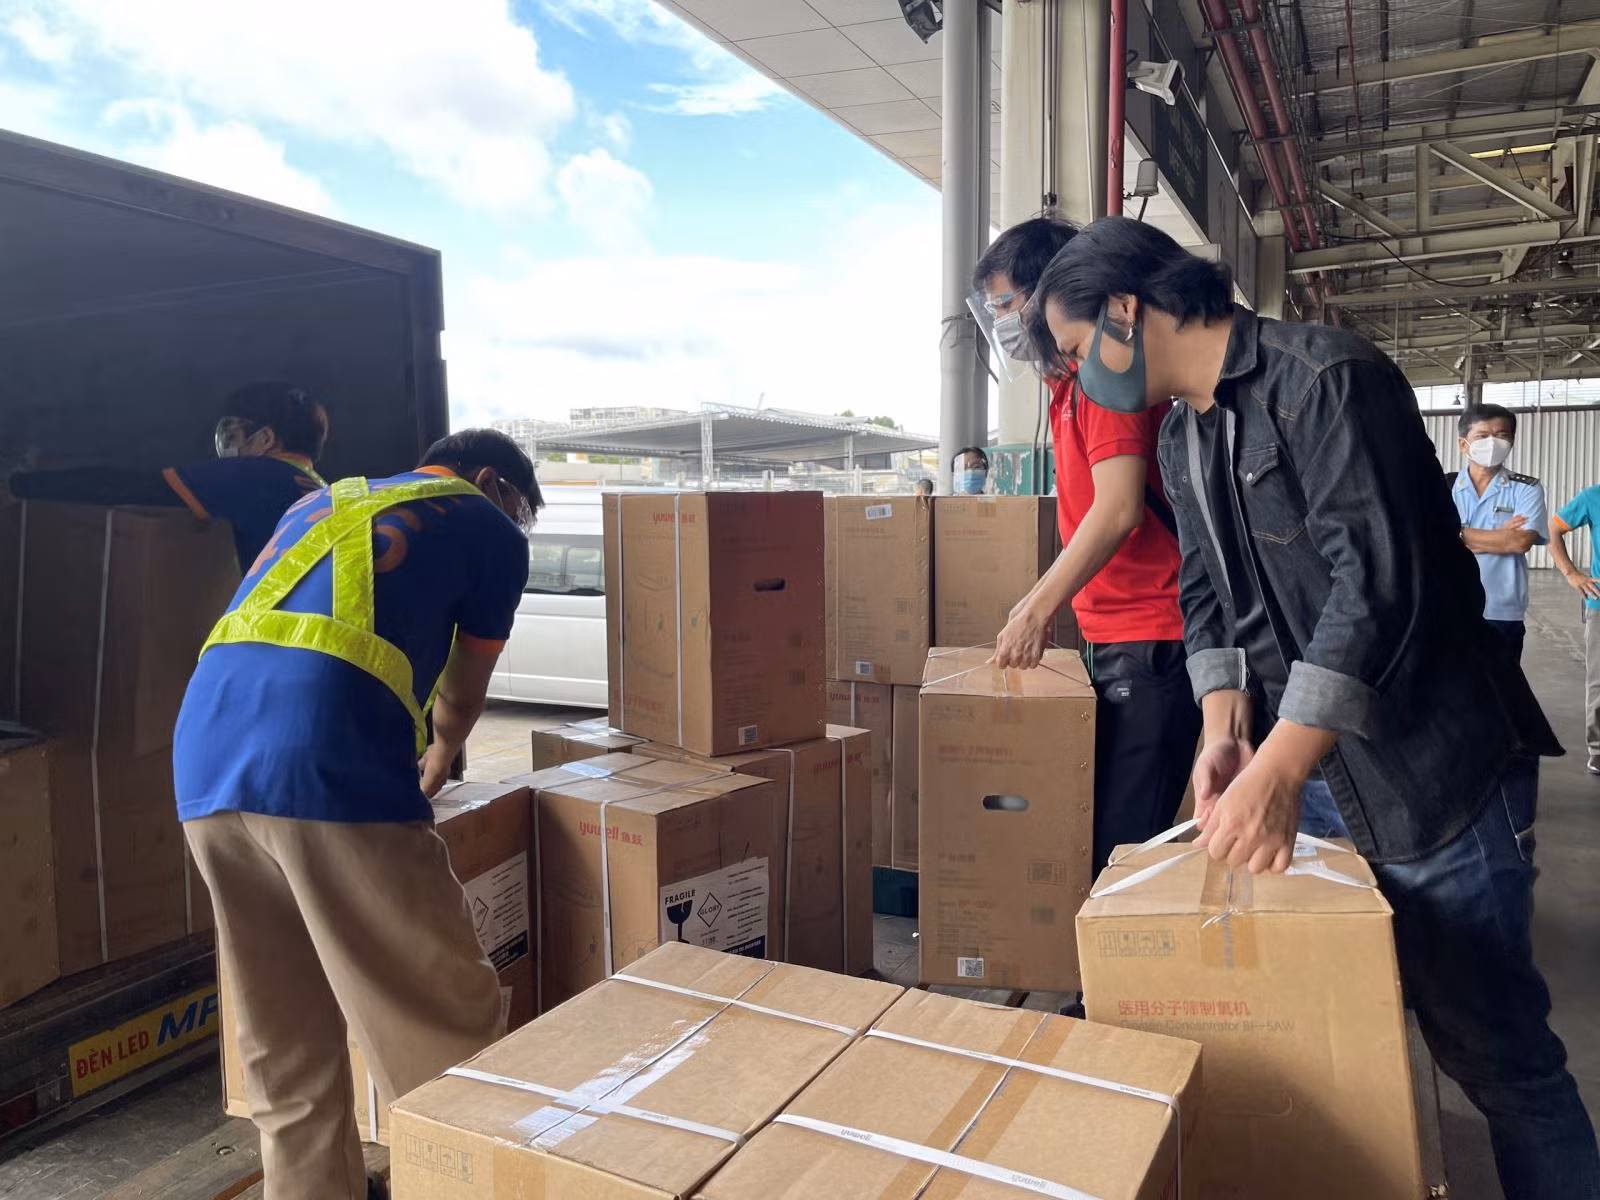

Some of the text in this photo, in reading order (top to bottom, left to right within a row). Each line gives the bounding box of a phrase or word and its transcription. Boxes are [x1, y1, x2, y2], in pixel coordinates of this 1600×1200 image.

[664, 889, 696, 905] FRAGILE
[76, 1047, 113, 1079] ĐÈN
[117, 1030, 149, 1060] LED
